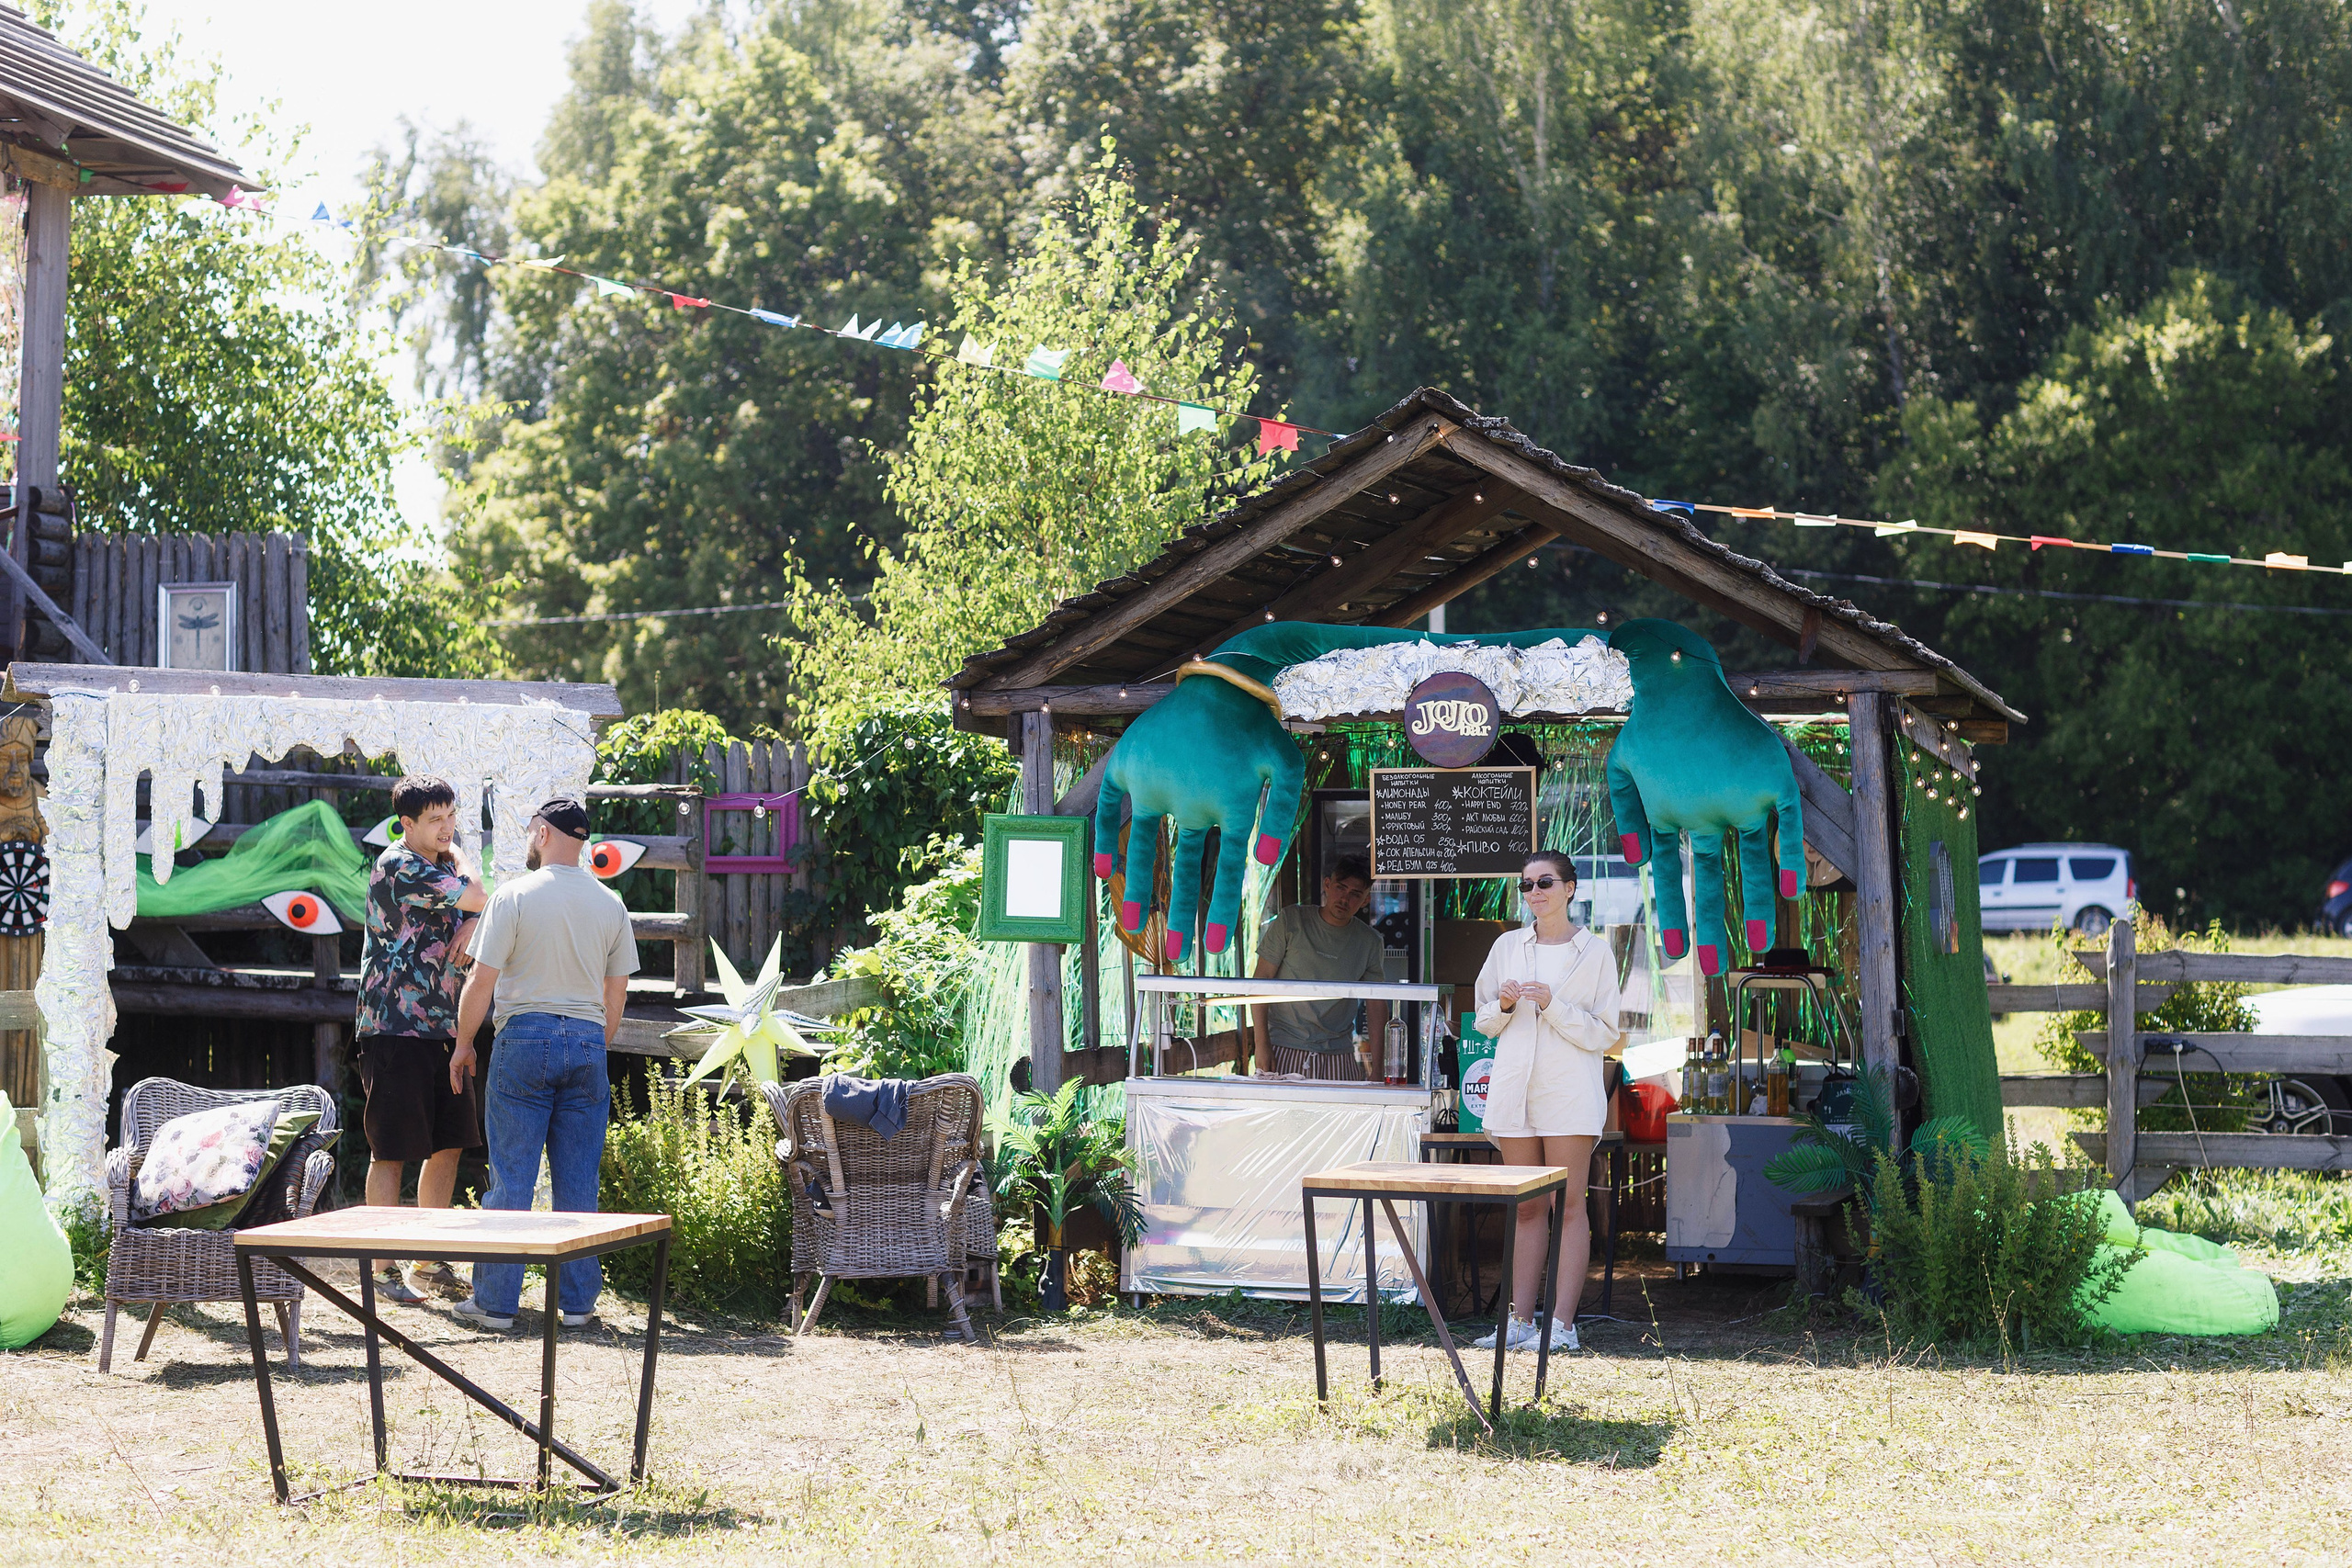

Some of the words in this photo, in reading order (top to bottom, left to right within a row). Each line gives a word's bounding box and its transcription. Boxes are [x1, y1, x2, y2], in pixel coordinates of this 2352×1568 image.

[1411, 699, 1488, 735] JOJO
[1460, 721, 1492, 736] bar
[1382, 786, 1430, 798] ЛИМОНАДЫ
[1464, 784, 1522, 800] КОКТЕЙЛИ
[1384, 800, 1407, 809] HONEY
[1408, 800, 1427, 809] PEAR
[1464, 800, 1485, 809] HAPPY
[1487, 800, 1501, 809] END
[1385, 812, 1411, 820] МАЛИБУ
[1465, 812, 1479, 822] АКТ
[1482, 813, 1506, 822] ЛЮБВИ
[1385, 820, 1425, 830] ФРУКТОВЫЙ
[1465, 824, 1495, 834] РАЙСКИЙ
[1495, 826, 1509, 835] САД
[1385, 834, 1409, 845] ВОДА
[1466, 840, 1500, 853] ПИВО
[1385, 847, 1400, 857] СОК
[1402, 847, 1435, 858] АПЕЛЬСИН
[1386, 860, 1404, 872] РЕД
[1466, 1084, 1488, 1094] MAR
